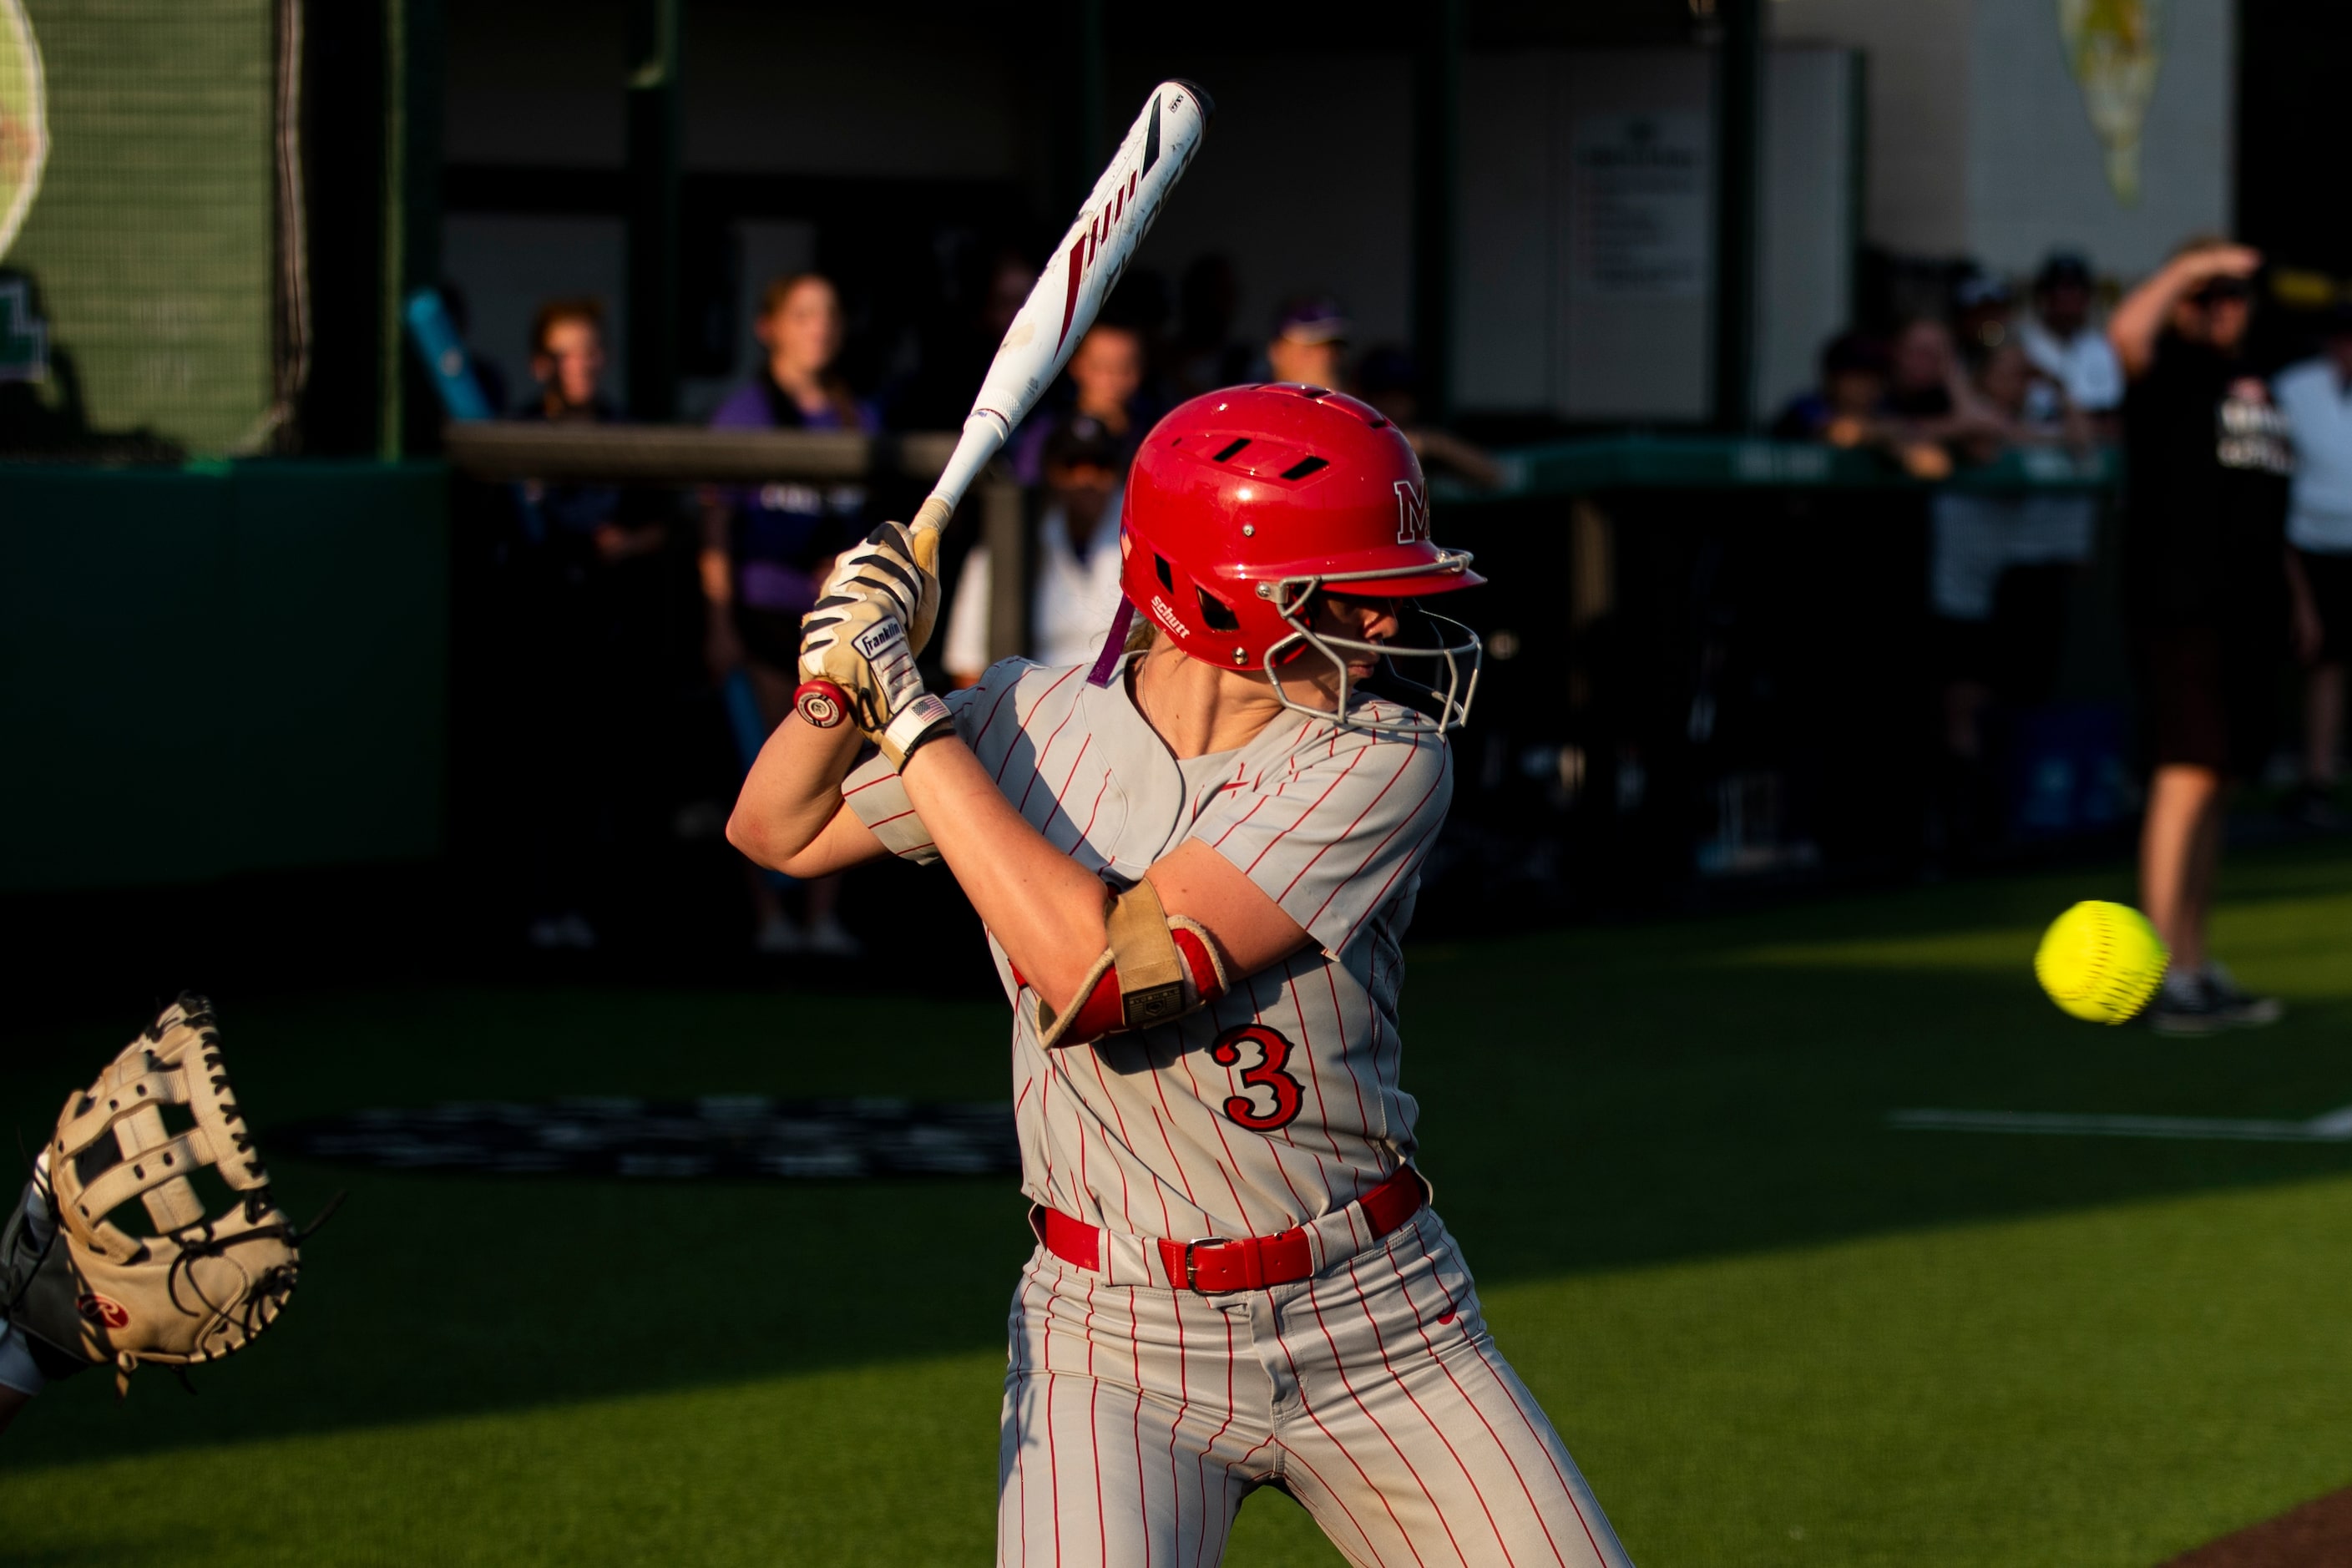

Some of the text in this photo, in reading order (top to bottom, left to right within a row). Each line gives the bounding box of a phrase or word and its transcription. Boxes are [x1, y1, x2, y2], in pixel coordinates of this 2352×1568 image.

[1393, 478, 1430, 544] M
[862, 623, 901, 656] Franklin
[1151, 595, 1191, 639] schutt
[1211, 1024, 1306, 1132] 3
